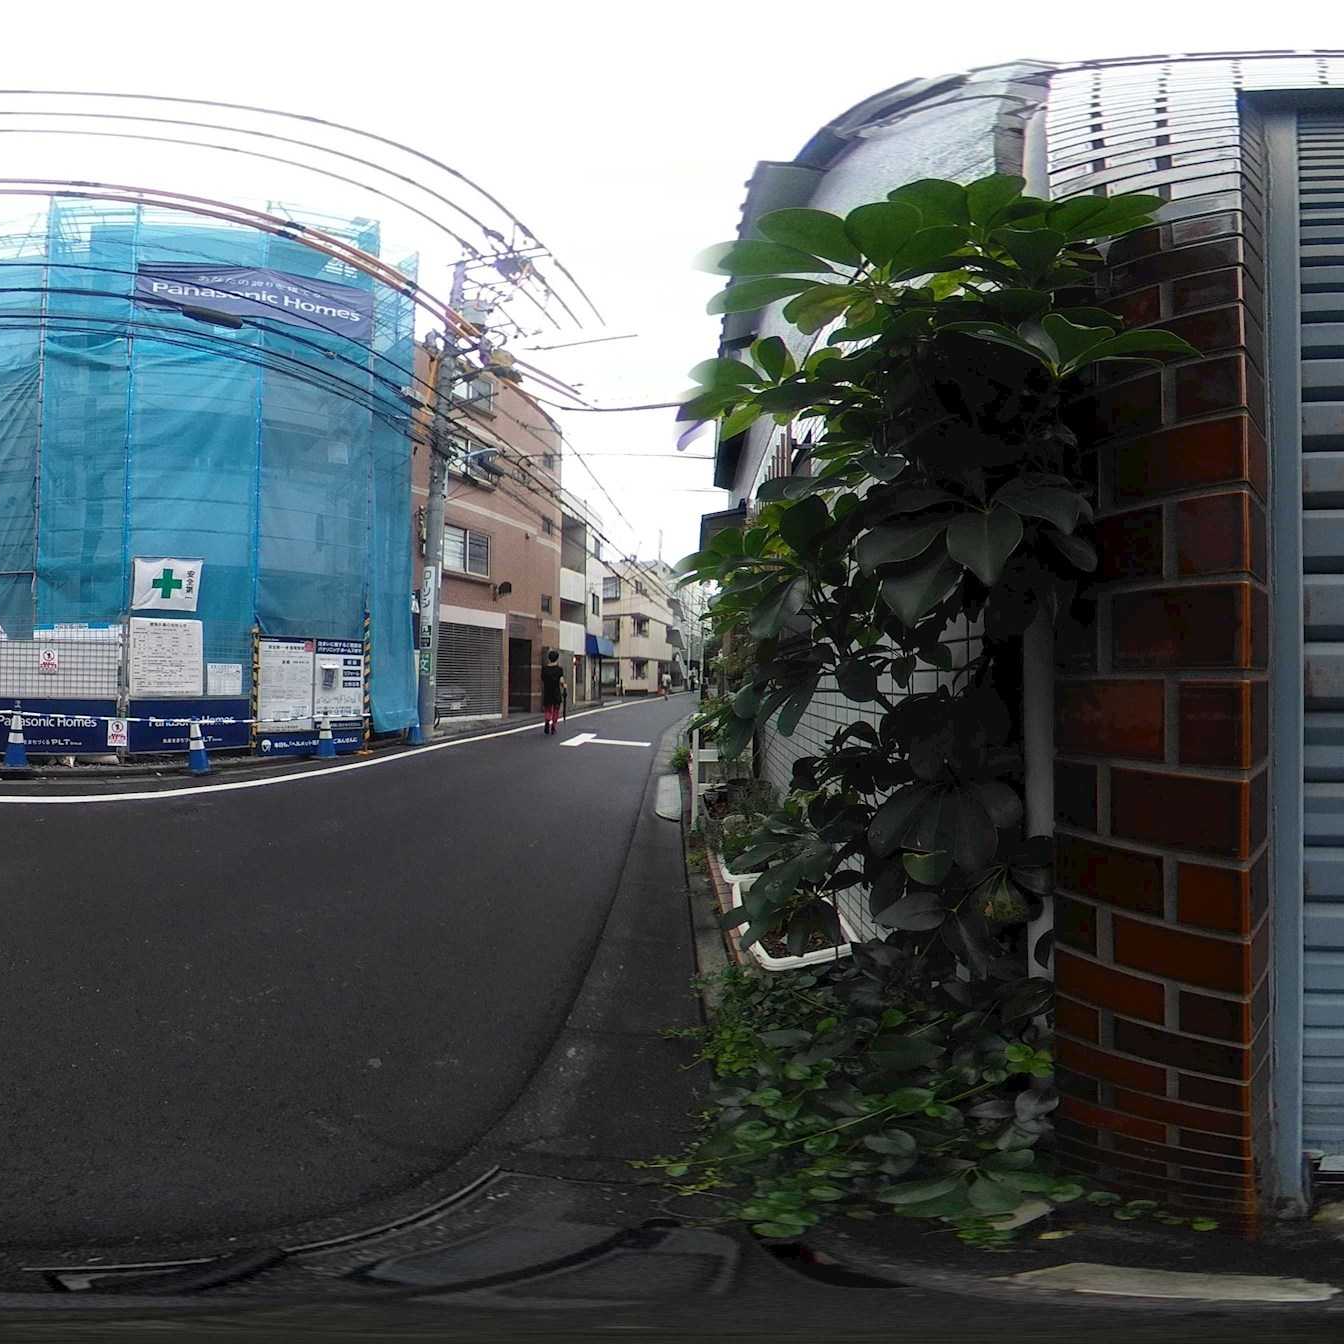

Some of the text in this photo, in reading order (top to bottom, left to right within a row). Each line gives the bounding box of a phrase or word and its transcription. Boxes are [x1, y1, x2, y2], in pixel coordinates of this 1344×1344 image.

[152, 282, 362, 322] Panasonic Homes
[57, 716, 97, 728] Homes
